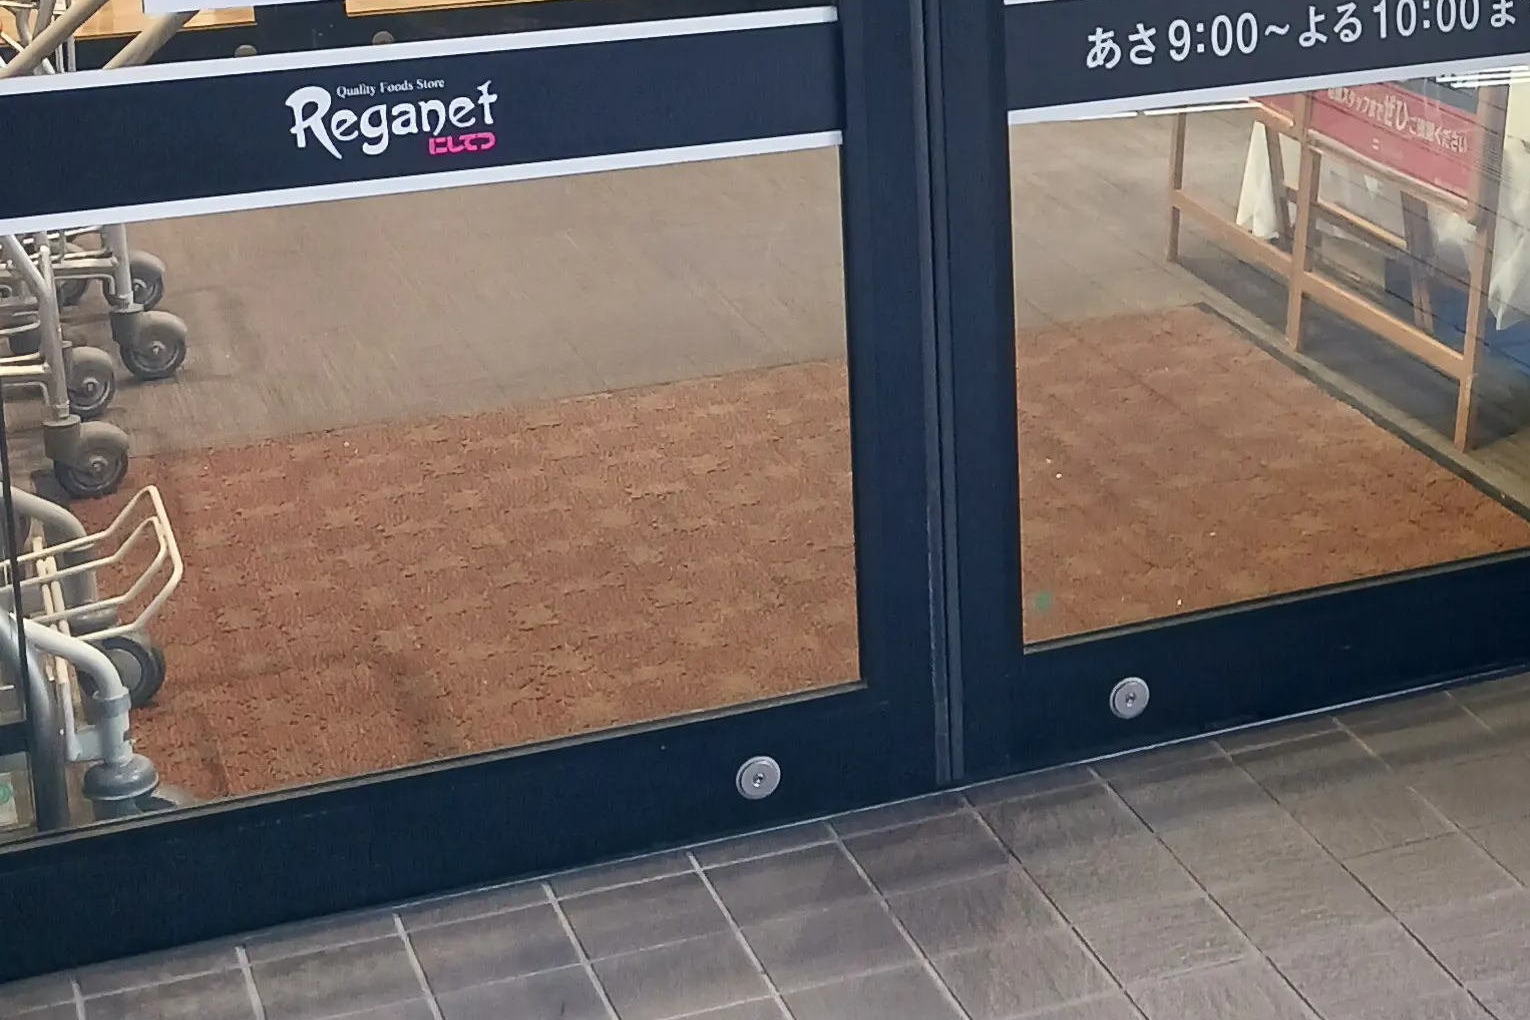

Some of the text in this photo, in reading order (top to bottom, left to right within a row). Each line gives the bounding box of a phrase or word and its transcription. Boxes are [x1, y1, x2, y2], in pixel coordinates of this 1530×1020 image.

[336, 78, 445, 98] Quality Foods Store
[285, 80, 498, 160] Reganet
[428, 132, 496, 156] にしてつ
